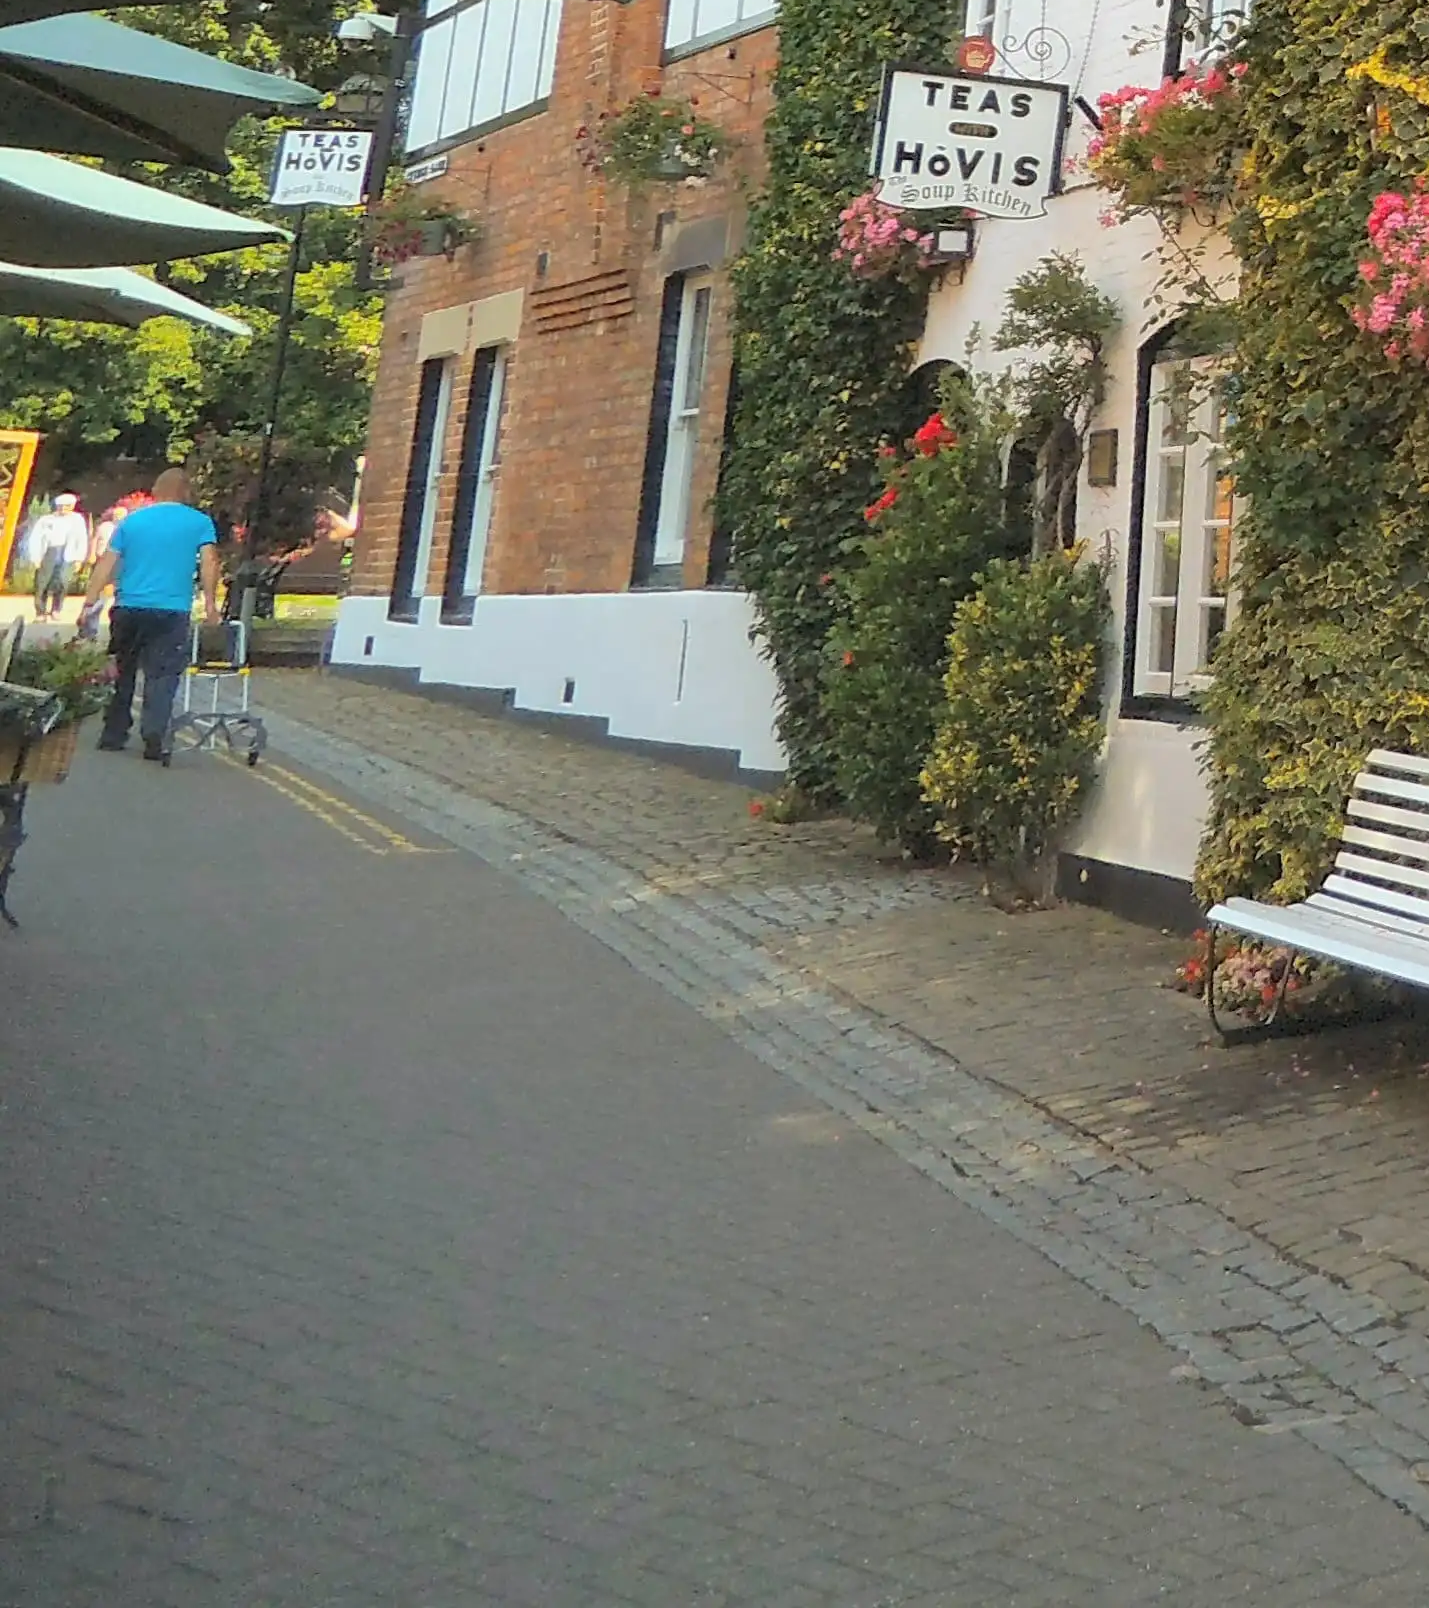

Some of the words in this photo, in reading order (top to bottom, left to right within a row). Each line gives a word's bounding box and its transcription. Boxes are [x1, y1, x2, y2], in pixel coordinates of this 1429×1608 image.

[922, 80, 1033, 118] TEAS
[299, 134, 359, 148] TEAS
[900, 184, 955, 203] Soup
[961, 183, 1032, 216] Kitchen
